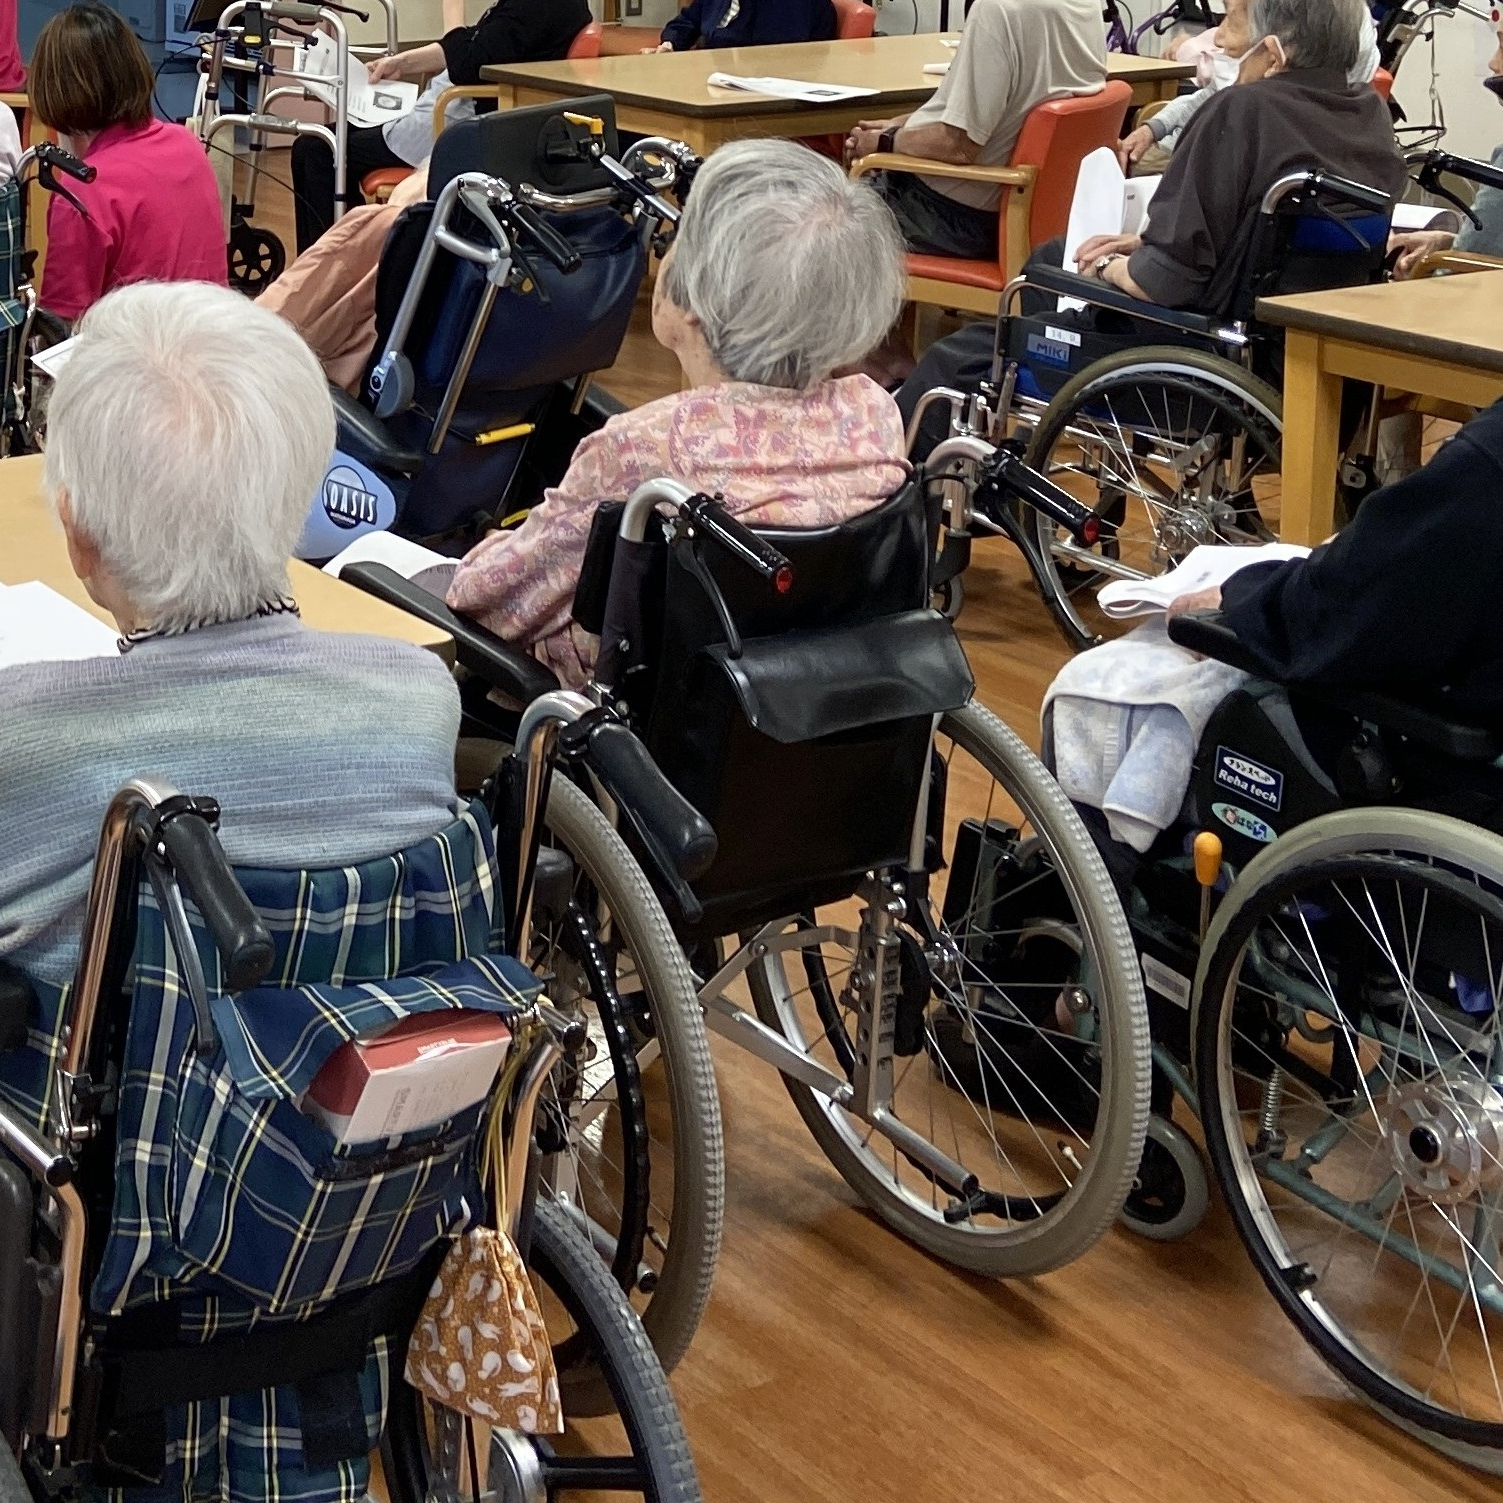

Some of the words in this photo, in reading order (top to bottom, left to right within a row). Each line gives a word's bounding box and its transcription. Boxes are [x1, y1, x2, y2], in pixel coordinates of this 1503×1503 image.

[329, 482, 376, 522] OASIS
[1218, 768, 1249, 790] Reha
[1250, 783, 1277, 803] tech
